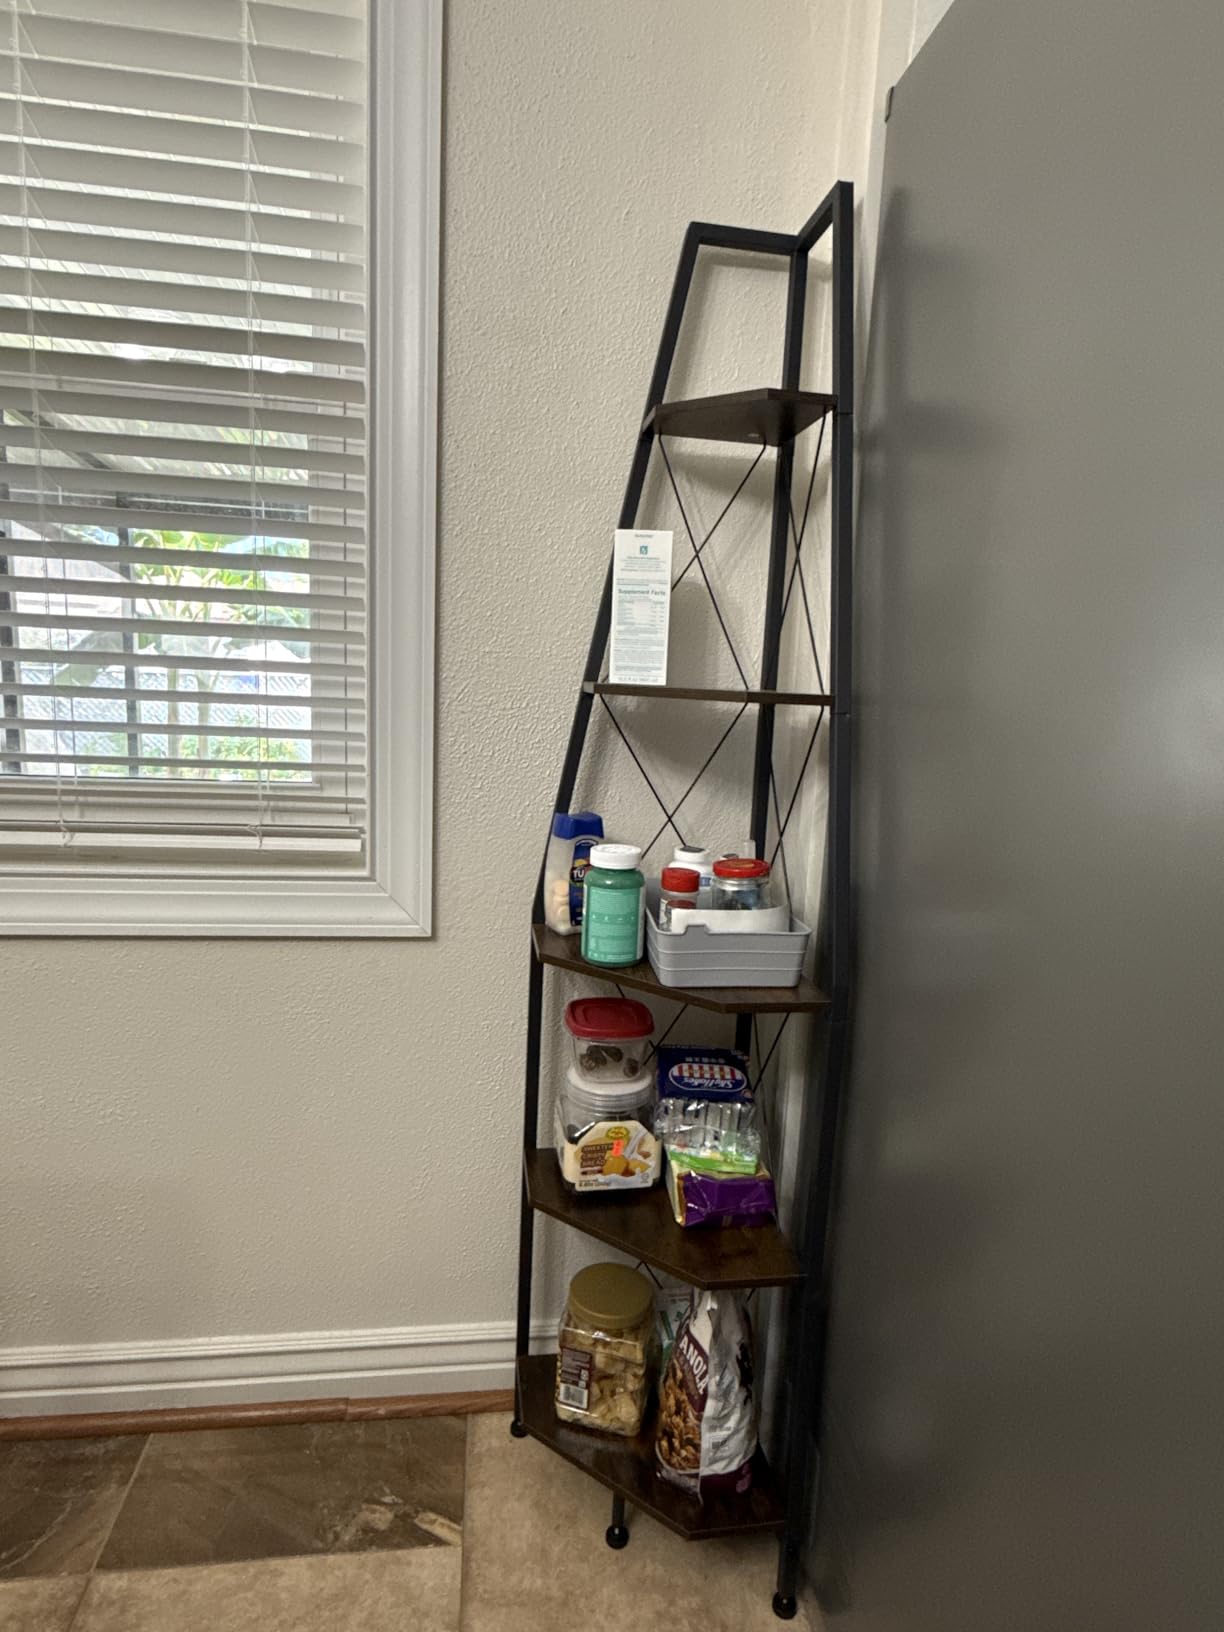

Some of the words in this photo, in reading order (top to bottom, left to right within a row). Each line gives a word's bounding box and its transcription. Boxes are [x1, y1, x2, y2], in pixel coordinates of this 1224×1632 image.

[618, 588, 650, 596] Supplement
[650, 588, 666, 596] Facts
[573, 869, 585, 878] TU
[679, 1332, 709, 1396] ANOLA
